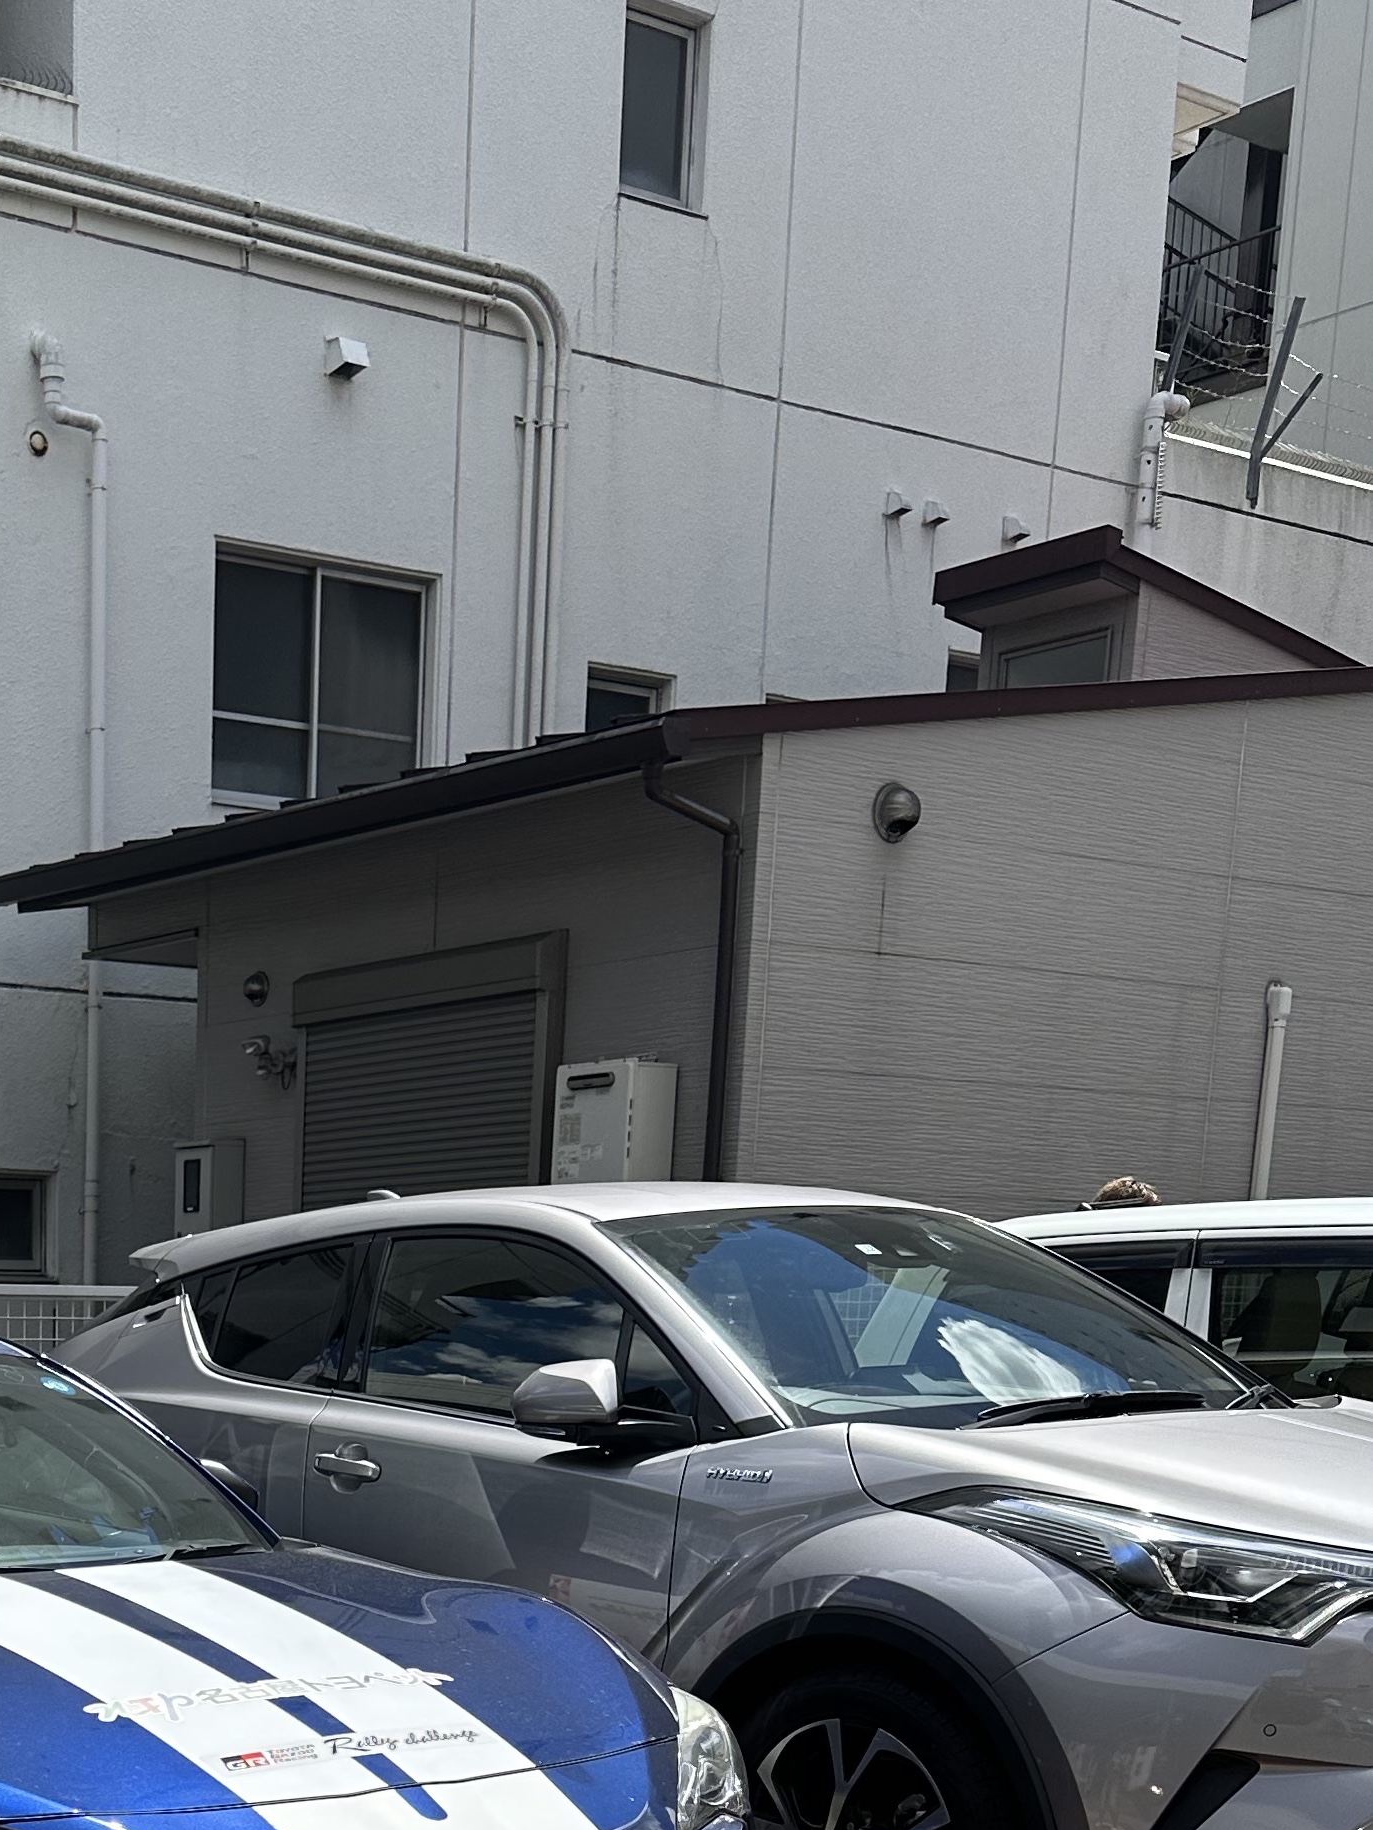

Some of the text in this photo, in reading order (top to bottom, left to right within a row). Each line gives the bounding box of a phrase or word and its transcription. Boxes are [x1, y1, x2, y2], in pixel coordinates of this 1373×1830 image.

[324, 1729, 480, 1755] Rally challenge
[224, 1755, 270, 1772] GR
